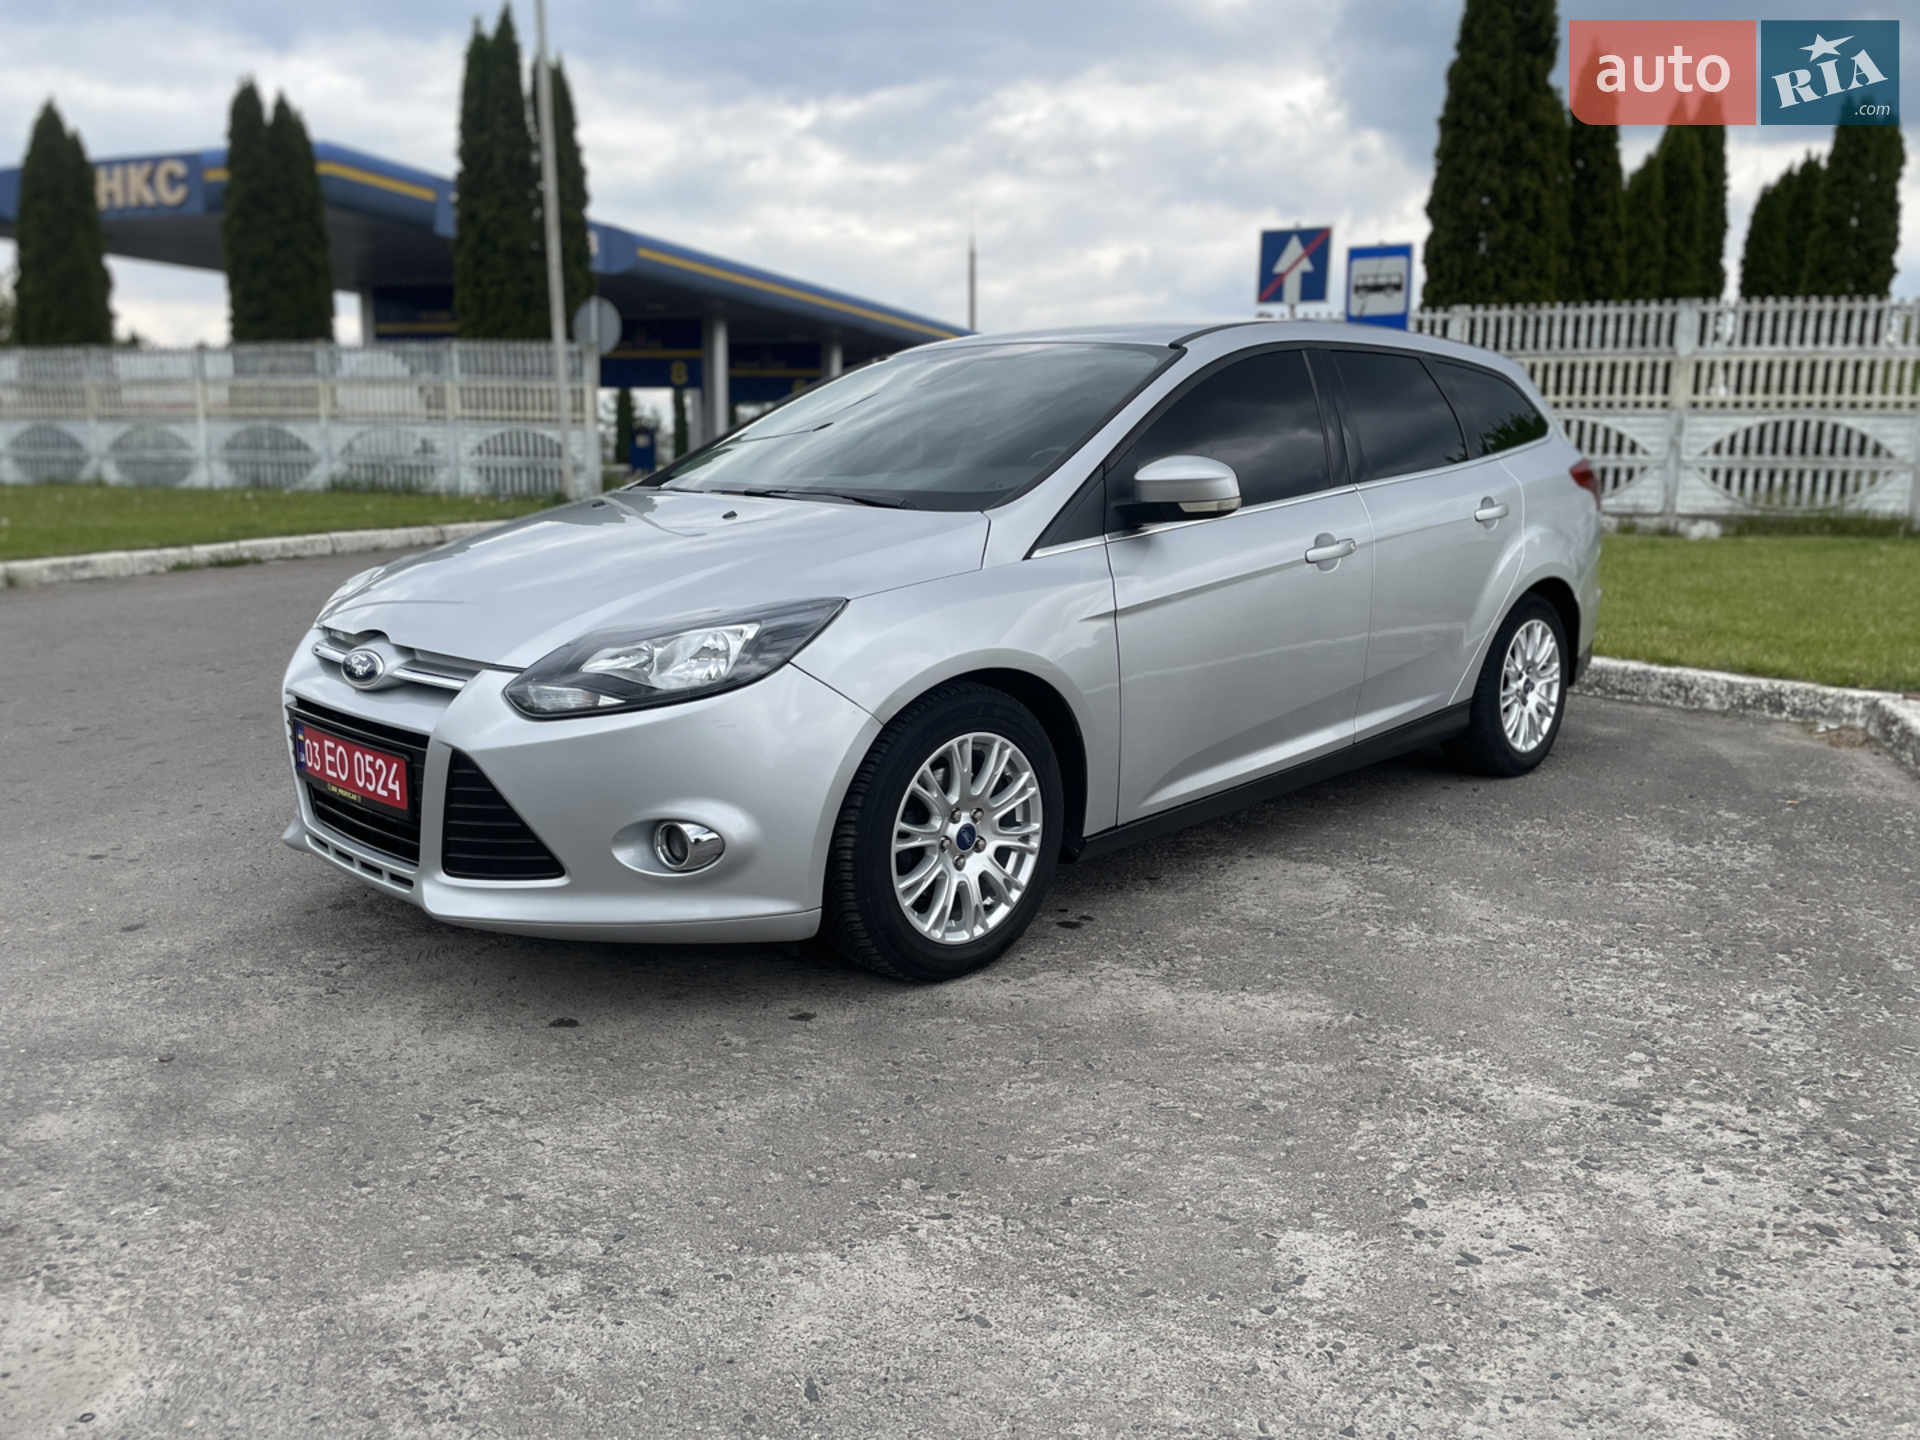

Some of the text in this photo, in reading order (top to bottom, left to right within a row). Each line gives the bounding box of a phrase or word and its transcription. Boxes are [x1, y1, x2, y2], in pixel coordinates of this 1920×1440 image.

[304, 739, 321, 771] 03
[324, 740, 349, 781] EO
[354, 751, 401, 801] 0524
